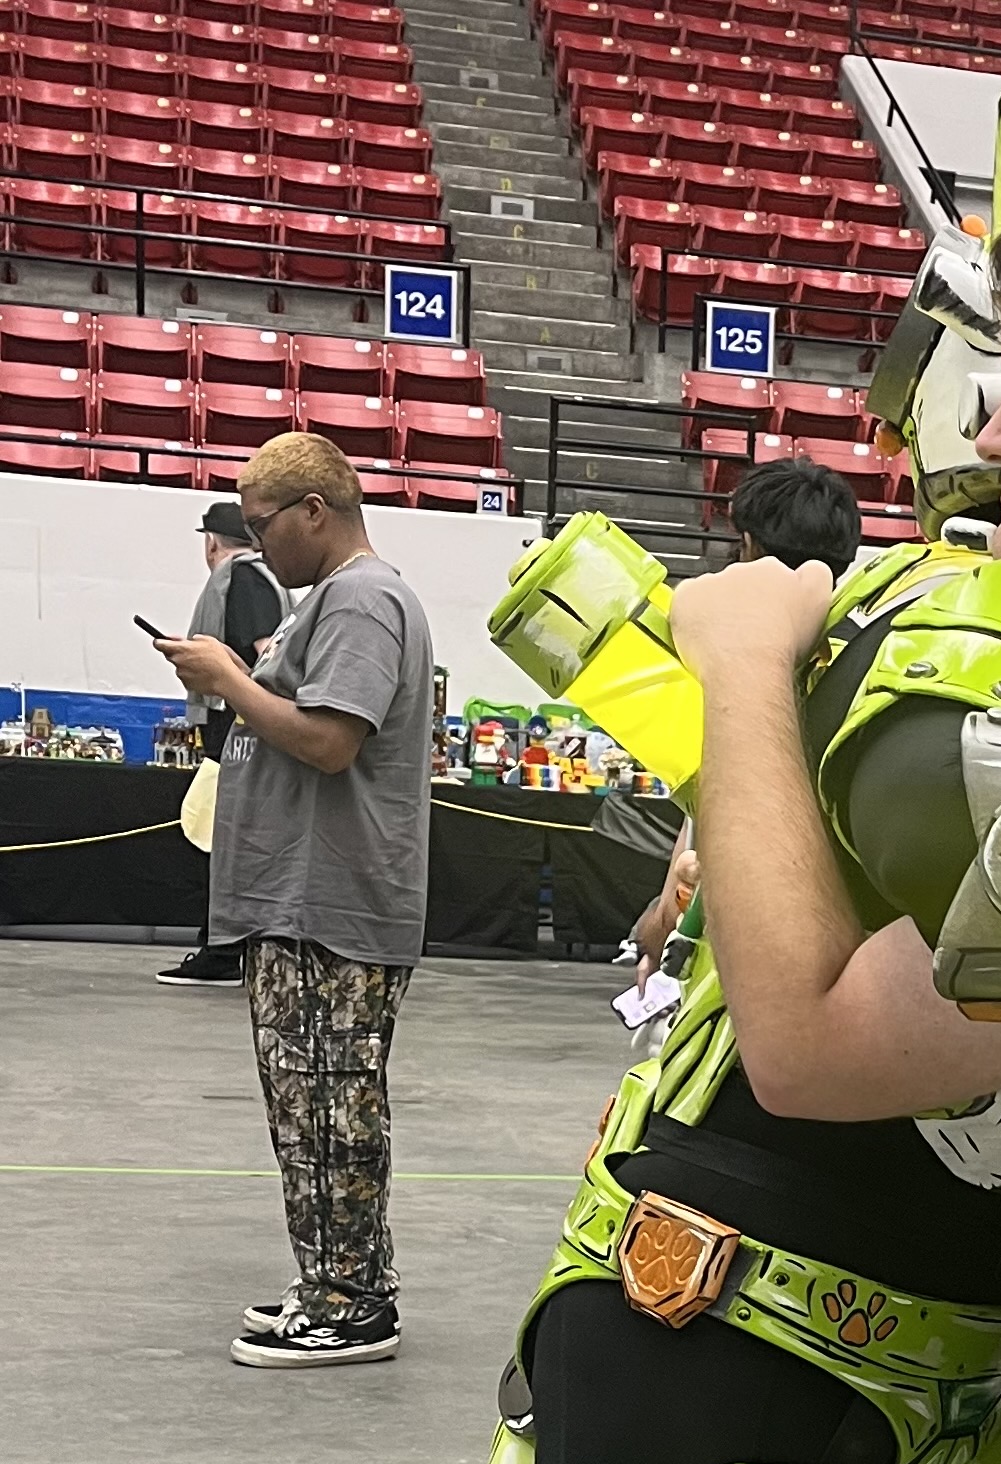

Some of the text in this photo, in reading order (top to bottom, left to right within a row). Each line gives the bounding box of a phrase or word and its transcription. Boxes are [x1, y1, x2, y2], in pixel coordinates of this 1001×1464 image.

[394, 290, 446, 319] 124
[715, 326, 763, 354] 125
[585, 461, 599, 480] C
[483, 494, 500, 508] 24
